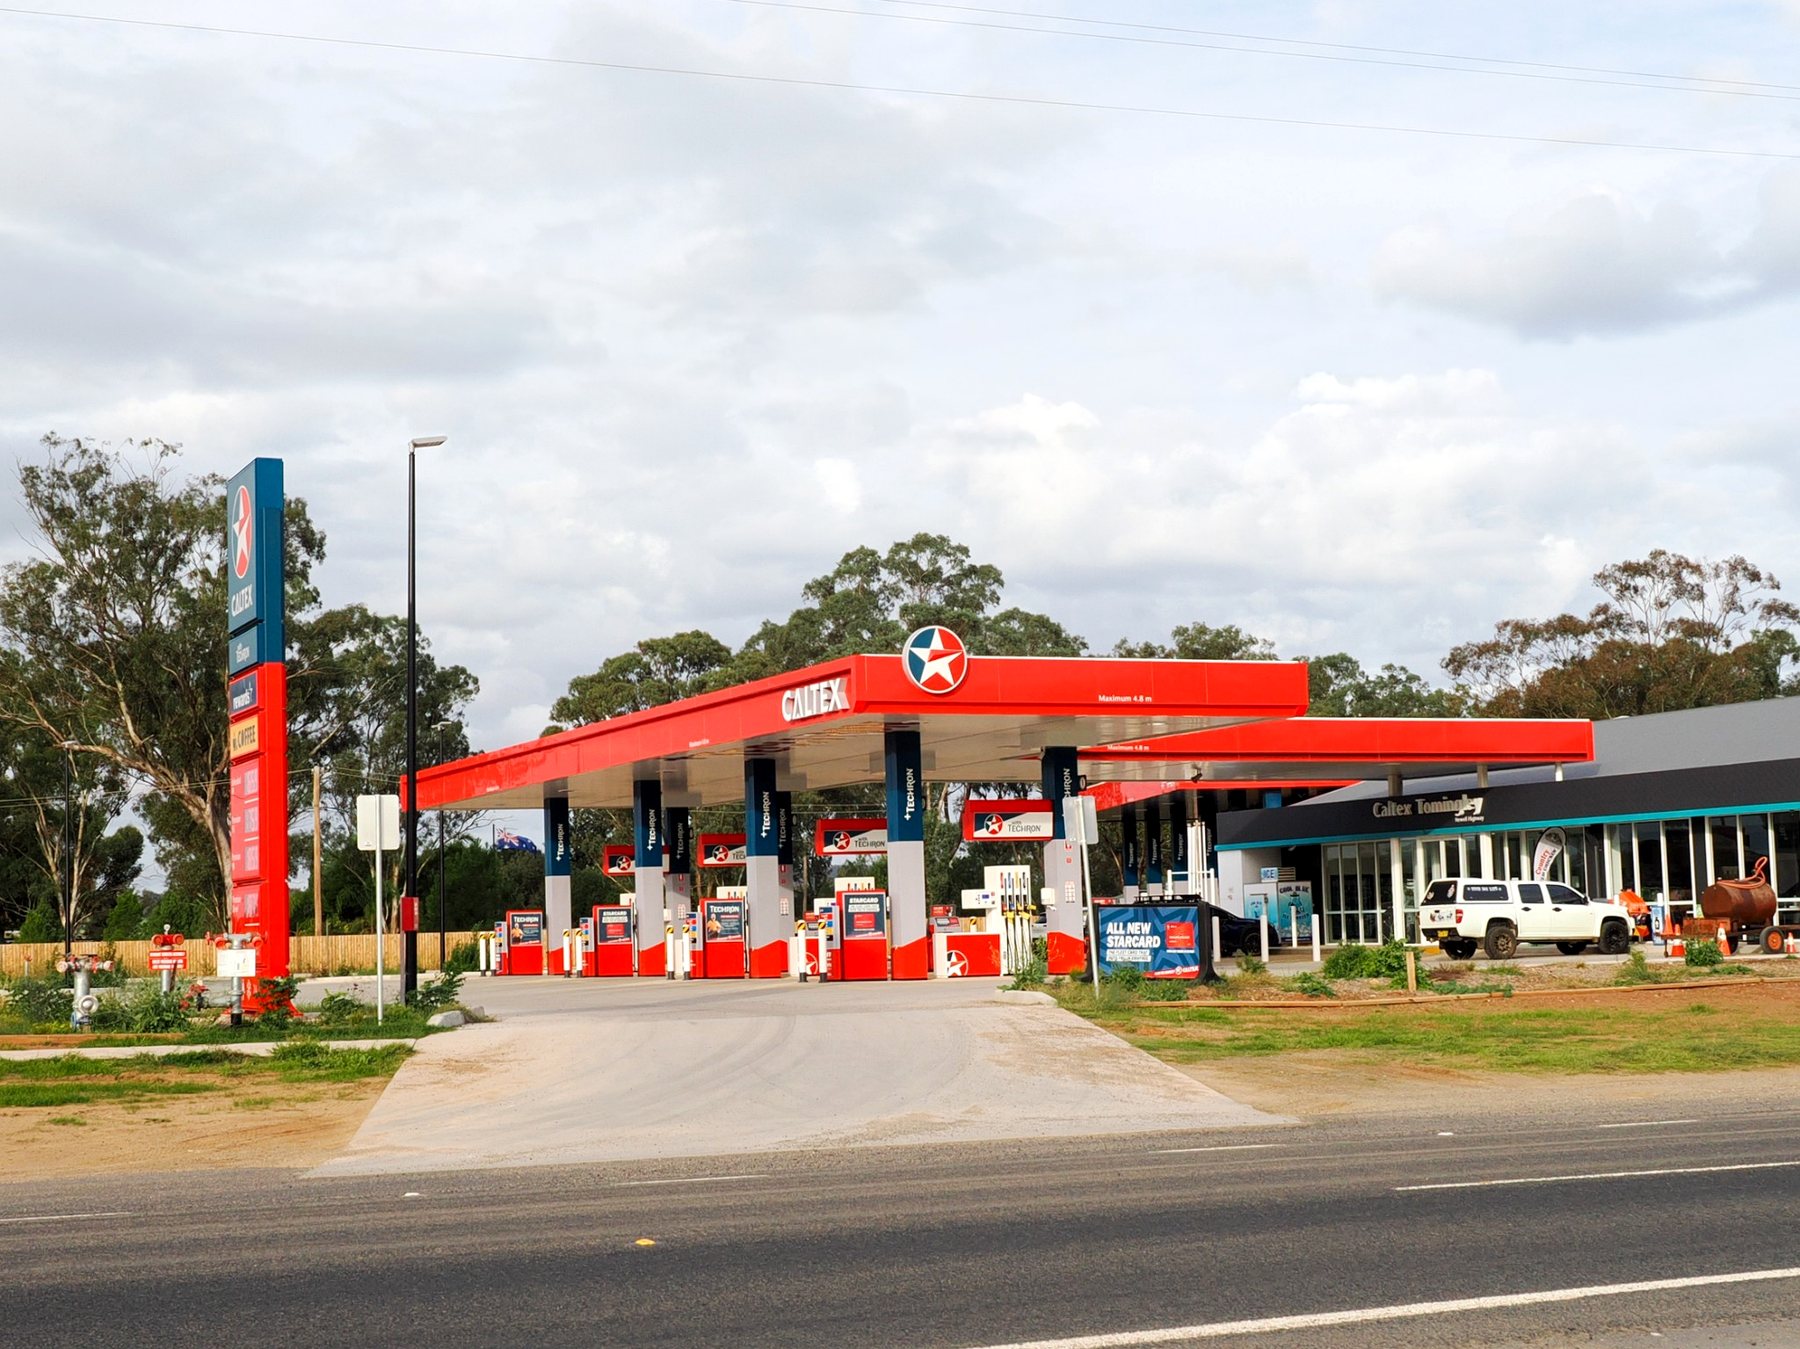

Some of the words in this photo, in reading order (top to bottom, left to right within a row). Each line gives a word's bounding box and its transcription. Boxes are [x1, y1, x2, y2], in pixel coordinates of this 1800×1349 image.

[231, 583, 253, 617] CALTEX
[781, 677, 848, 722] CALTEX
[1098, 694, 1132, 702] Maximum
[1133, 694, 1144, 702] 4.8
[1372, 800, 1413, 818] Caltex
[1008, 824, 1042, 834] TECHRON
[855, 840, 886, 849] TECHRON
[1106, 922, 1126, 935] ALL
[1127, 922, 1152, 935] NEW
[1106, 935, 1161, 948] STARCARD
